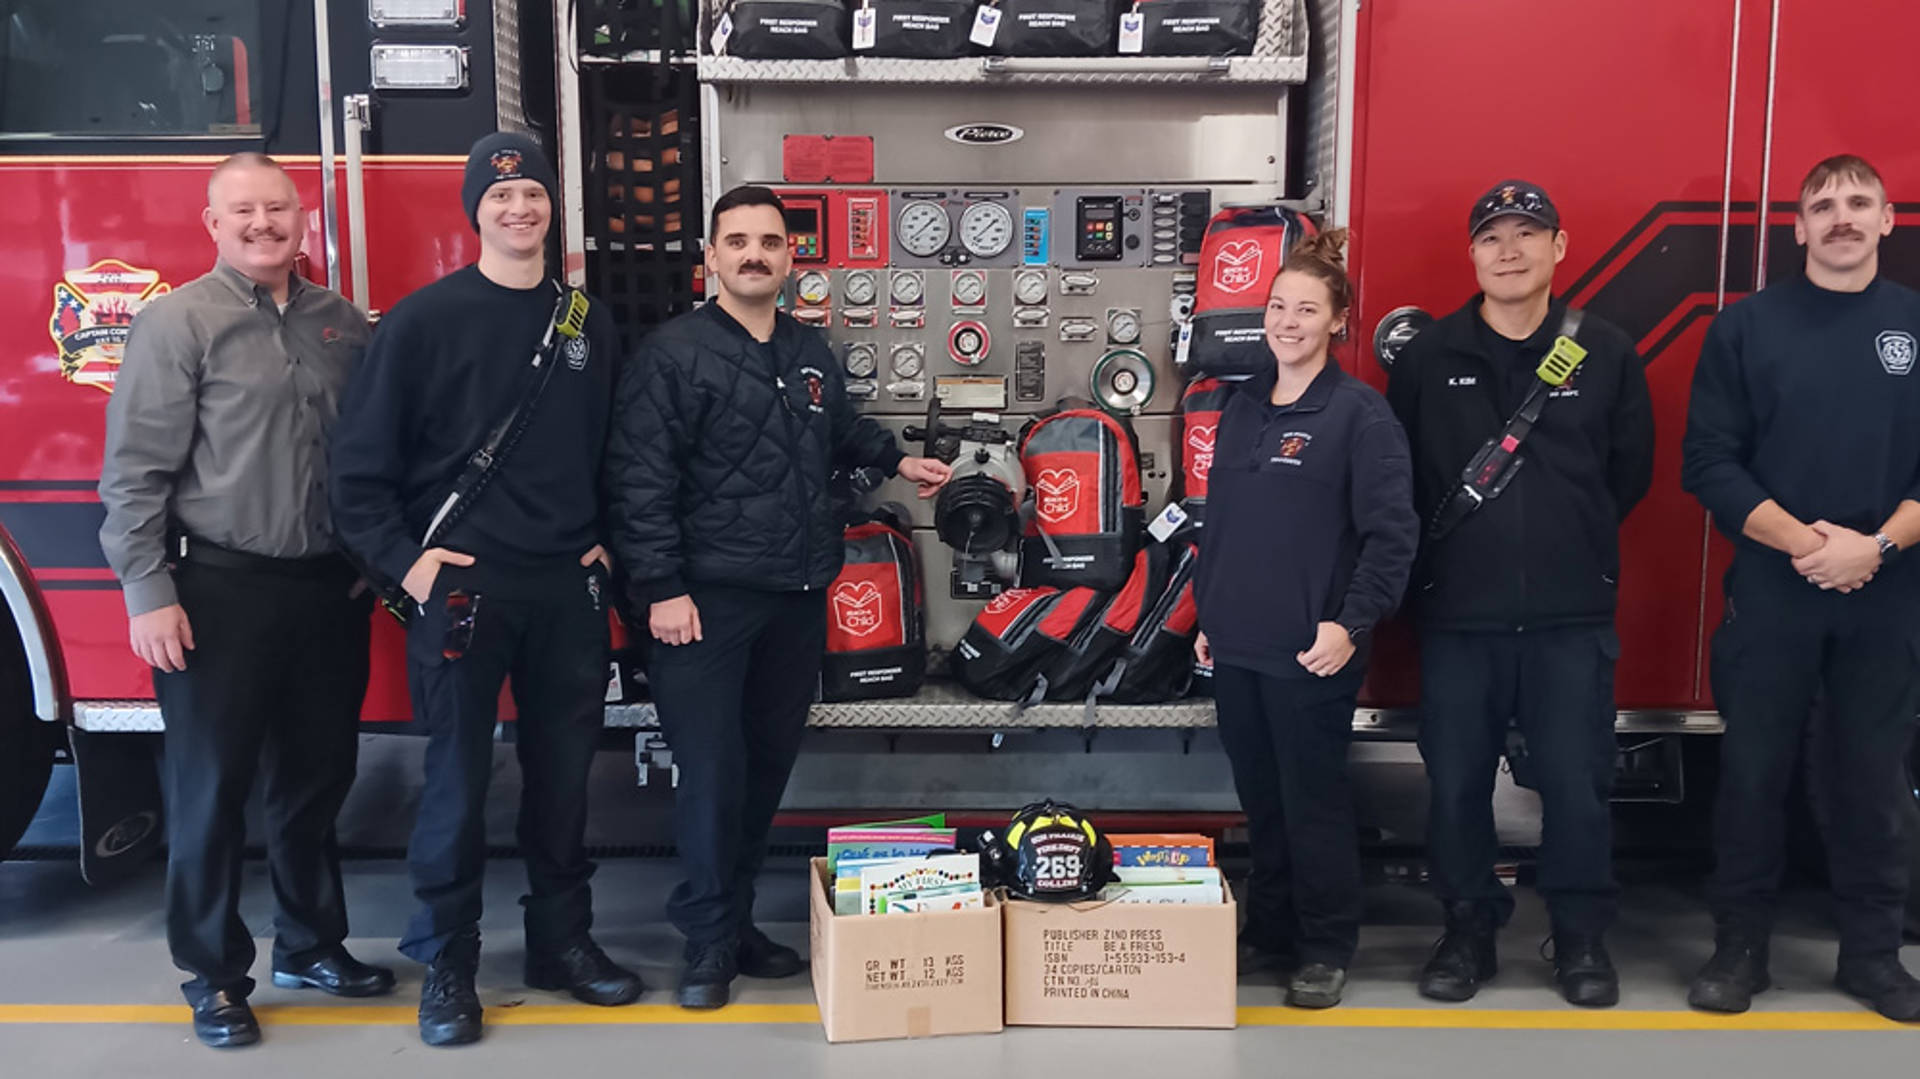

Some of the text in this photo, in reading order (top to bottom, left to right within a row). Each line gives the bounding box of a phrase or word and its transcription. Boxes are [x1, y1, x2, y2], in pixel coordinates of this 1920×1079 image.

[912, 15, 950, 24] RESPONDER
[1037, 13, 1076, 21] RESPONDER
[1181, 17, 1220, 25] RESPONDER
[779, 19, 818, 27] RESPONDER
[959, 126, 1010, 140] Pierce
[867, 667, 902, 676] RESPONDER
[1036, 855, 1080, 879] 269
[1037, 879, 1079, 889] COLLINS
[1043, 929, 1099, 940] PUBLISHER
[1130, 929, 1162, 940] PRESS
[1044, 941, 1073, 952] TITLE
[1104, 941, 1116, 952] BE
[1119, 941, 1126, 951] A
[1044, 953, 1068, 963] ISBN
[1060, 964, 1142, 975] COPIES/CARTON
[866, 971, 886, 982] NET
[924, 968, 935, 979] 12
[1043, 976, 1064, 986] CTN
[1043, 987, 1130, 999] PRINTED IN CHINA
